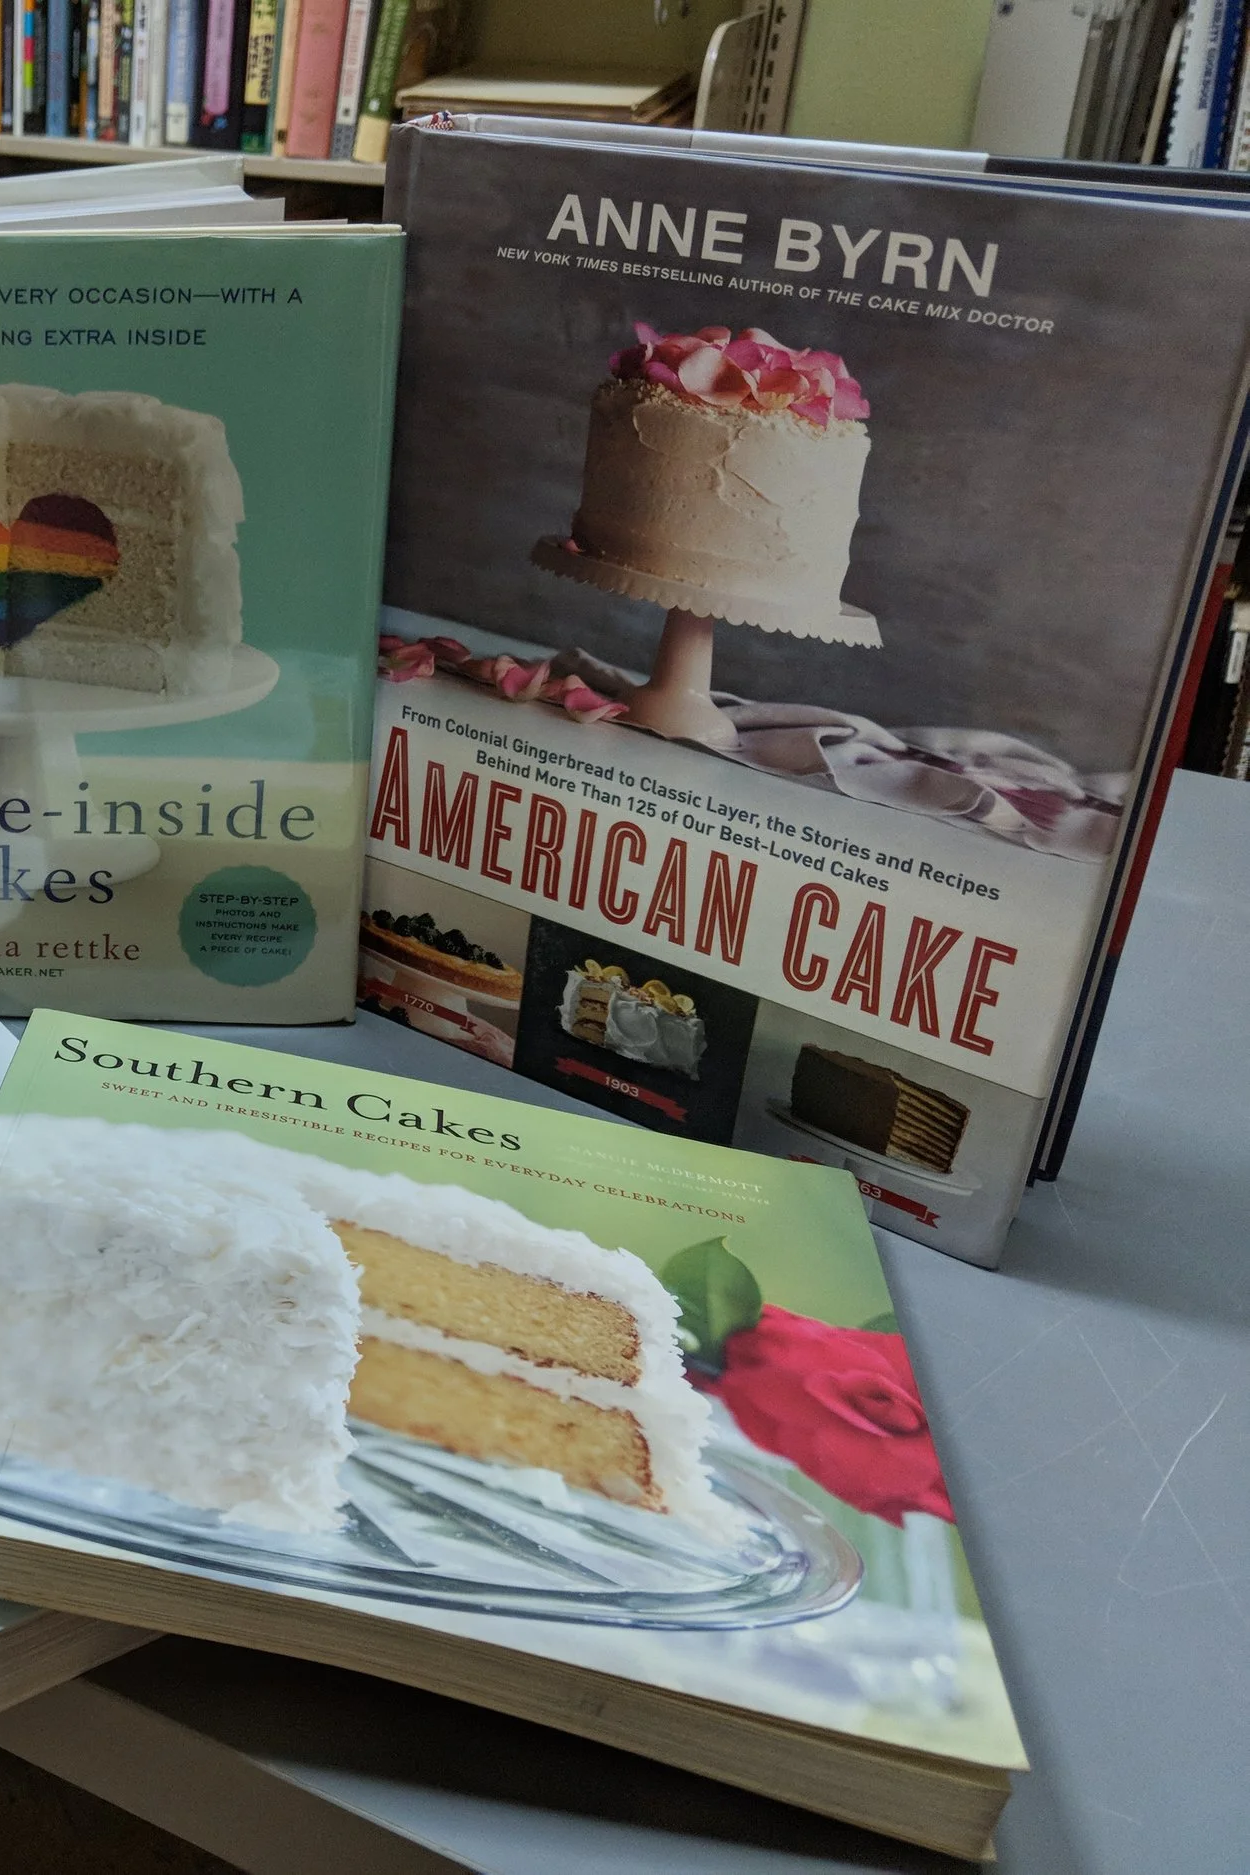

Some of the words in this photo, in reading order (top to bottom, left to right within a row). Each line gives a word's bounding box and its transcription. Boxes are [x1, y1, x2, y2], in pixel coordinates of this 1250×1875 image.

[546, 193, 749, 265] ANNE
[773, 217, 1000, 298] BYRN
[286, 287, 303, 304] A
[496, 246, 529, 262] NEW
[533, 250, 571, 268] YORK
[575, 256, 619, 274] TIMES
[622, 261, 724, 288] BESTSELLING
[727, 275, 794, 298] AUTHOR
[798, 284, 822, 300] OF
[826, 288, 863, 308] THE
[867, 293, 921, 316] CAKE
[925, 301, 962, 322] MIX
[966, 308, 1055, 335] DOCTOR
[44, 329, 117, 346] EXTRA
[126, 329, 206, 346] INSIDE
[401, 704, 442, 730] From
[445, 715, 510, 751] Colonial
[512, 735, 615, 786] Gingerbread
[617, 768, 636, 788] to
[639, 774, 703, 808] Classic
[706, 793, 761, 830] Layer,
[766, 811, 798, 835] the
[801, 823, 871, 860] Stories
[874, 845, 915, 874] and
[918, 859, 1001, 903] Recipes
[476, 749, 531, 783] Behind
[534, 766, 579, 800] More
[582, 779, 623, 809] Than
[626, 793, 657, 820] 125
[660, 805, 679, 825] of
[683, 813, 716, 838] Our
[719, 824, 829, 874] Best-Loved
[830, 857, 891, 893] Cakes
[199, 894, 299, 906] STEP-BY-STEP
[369, 725, 758, 967] AMERICAN
[781, 881, 1019, 1057] CAKE
[215, 908, 256, 918] PHOTOS
[258, 910, 282, 919] AND
[195, 920, 268, 930] INSTRUCTIONS
[271, 922, 300, 932] MAKE
[210, 933, 243, 941] EVERY
[245, 934, 284, 943] RECIPE
[36, 932, 142, 962] rettke
[210, 945, 240, 954] PIECE
[244, 946, 257, 954] OF
[403, 993, 434, 1013] 1770
[53, 1034, 328, 1113] Southern
[346, 1091, 522, 1153] Cakes
[604, 1075, 640, 1099] 1903
[101, 1080, 163, 1101] SWEET
[167, 1092, 210, 1110] AND
[215, 1101, 346, 1137] IRRESISTIBLE
[352, 1128, 432, 1154] RECIPES
[437, 1146, 478, 1166] FOR
[484, 1156, 587, 1191] EVERYDAY
[593, 1183, 748, 1226] CELEBRATIONS
[646, 1161, 763, 1194] McDERMOTT
[855, 1179, 882, 1199] 63
